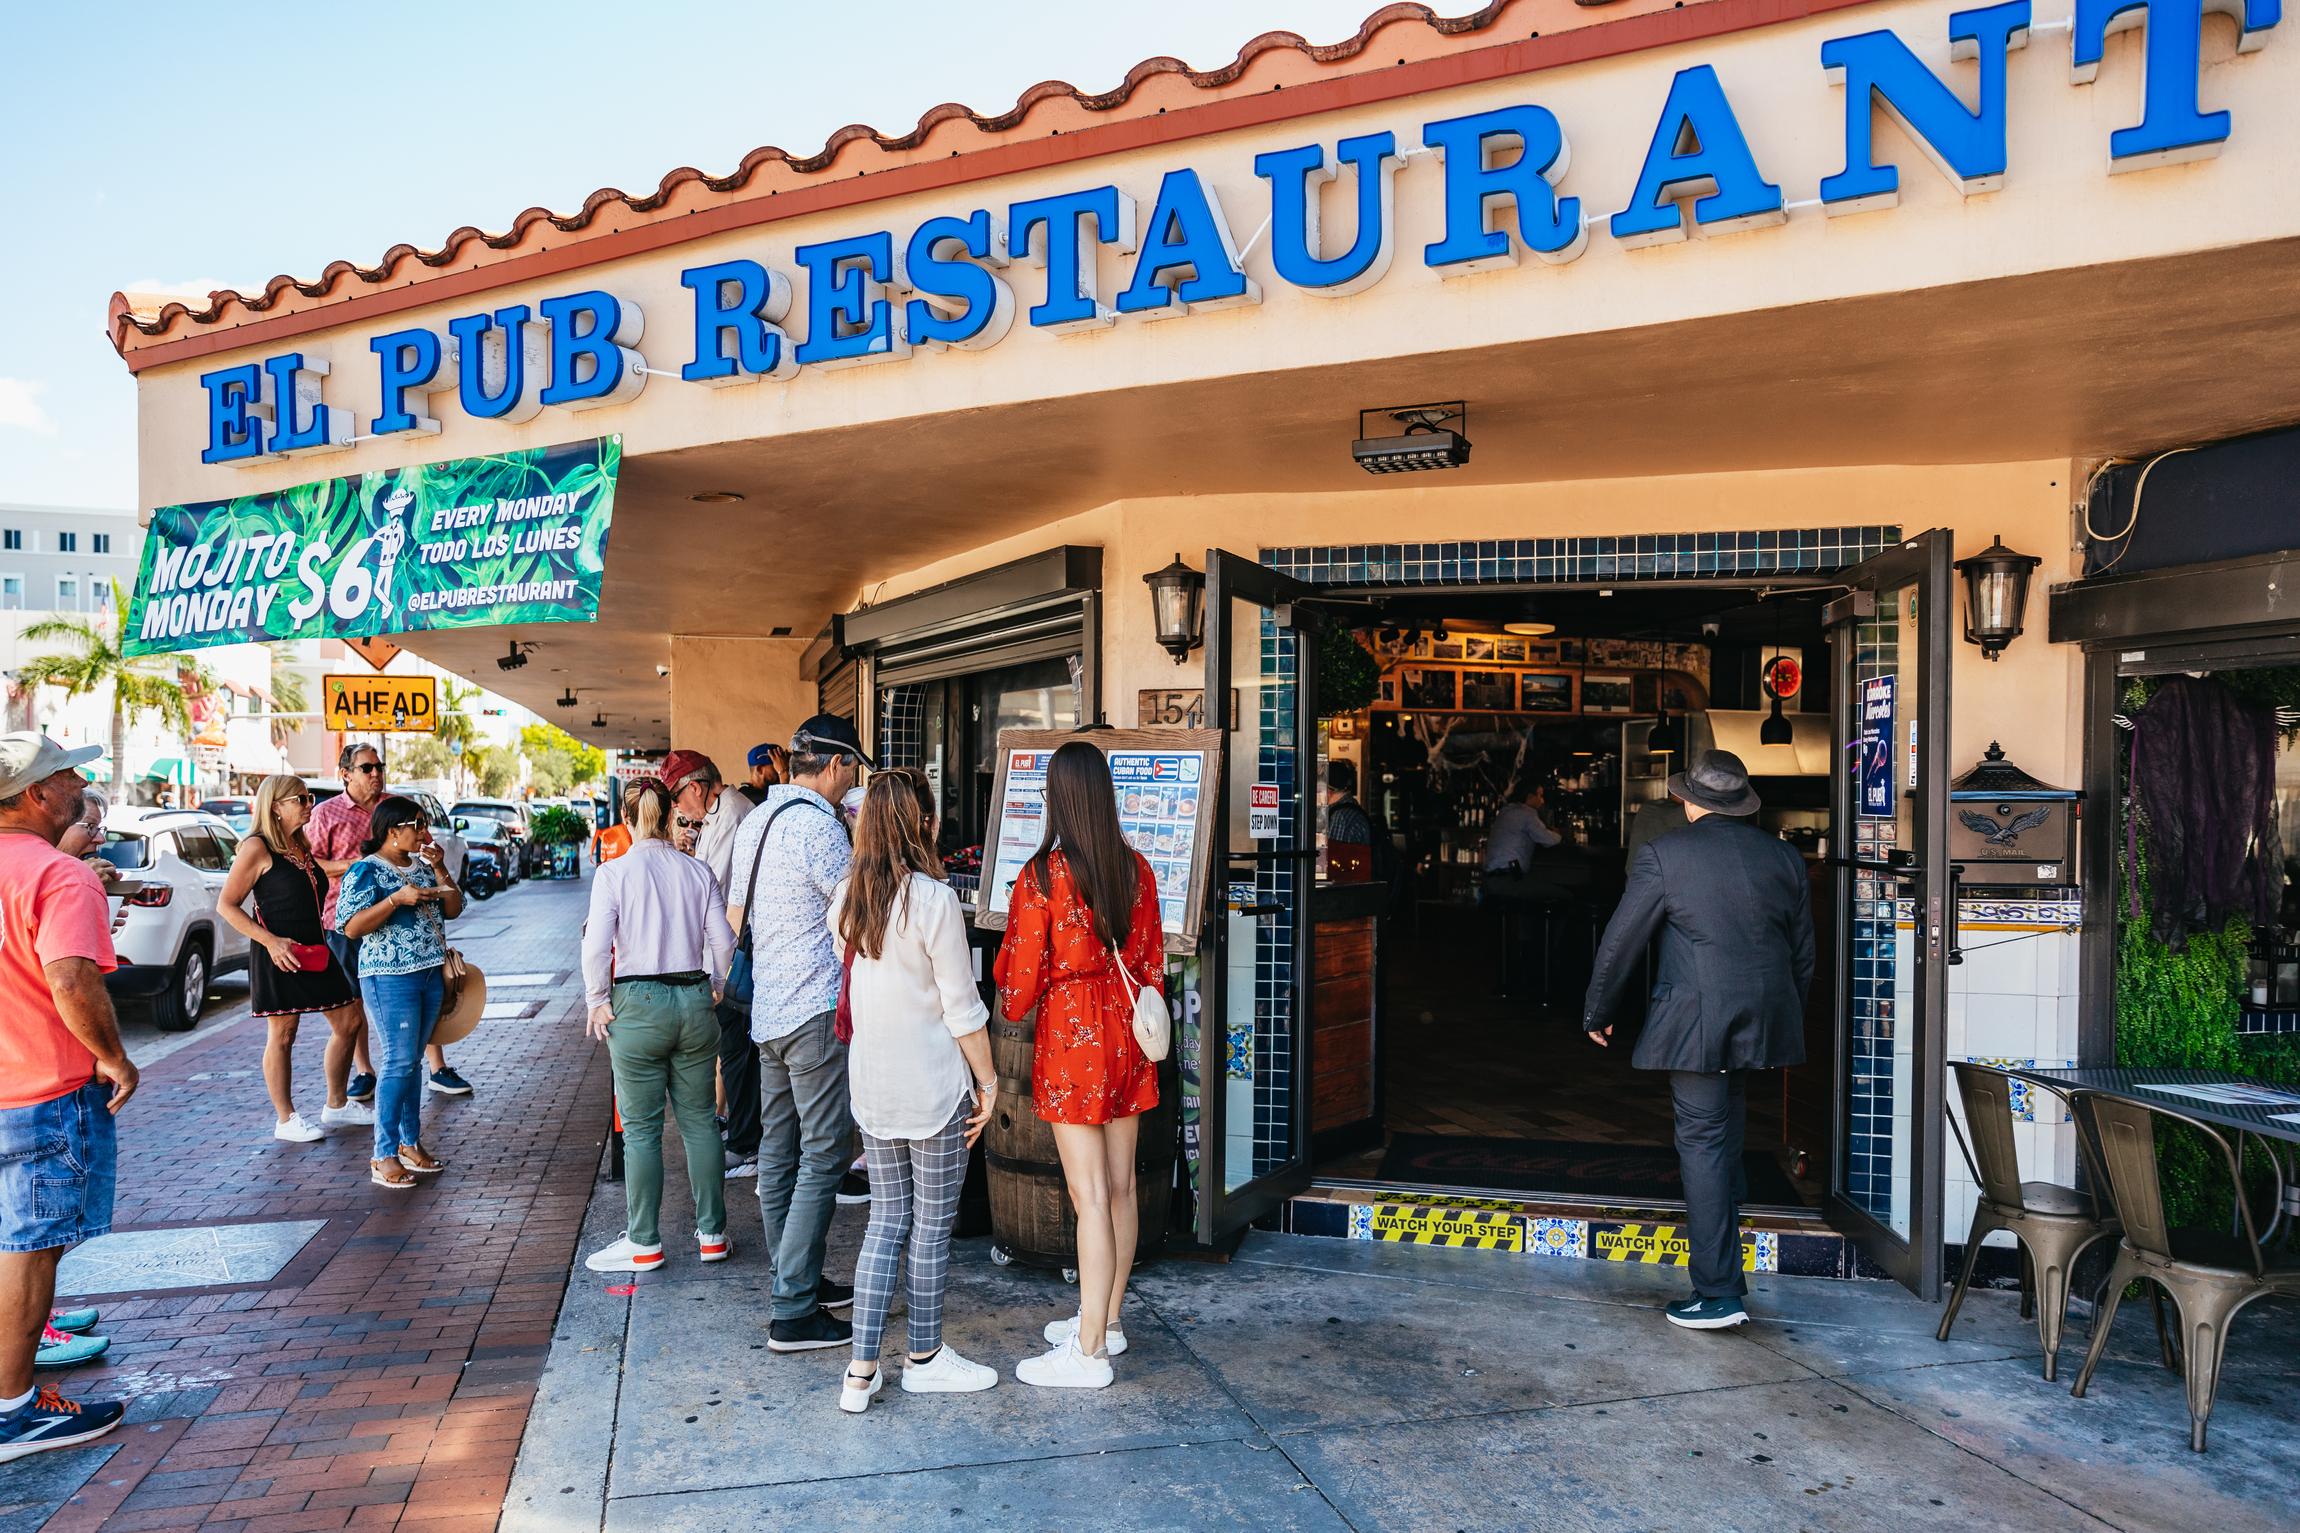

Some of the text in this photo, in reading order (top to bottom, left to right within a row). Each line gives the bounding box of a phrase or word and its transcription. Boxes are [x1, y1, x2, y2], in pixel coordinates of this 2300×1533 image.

[200, 0, 2283, 464] EL PUB RESTAURANT
[430, 492, 582, 532] EVERY MONDAY
[420, 525, 582, 565] TODO LOS LUNES
[149, 531, 297, 594] MOJITO
[287, 530, 376, 630] $6
[407, 579, 579, 612] @ELPUBRESTAURANT
[140, 583, 280, 640] MONDAY
[334, 691, 430, 717] AHEAD
[1112, 766, 1153, 776] CUBAN FOOD
[1113, 757, 1150, 767] AUTHENTIC
[1252, 789, 1277, 805] BE CAREFUL
[1251, 814, 1278, 830] STEP DOWN
[1377, 1217, 1517, 1239] WATCH YOUR STEP
[1600, 1236, 1690, 1254] WATCH YOU
